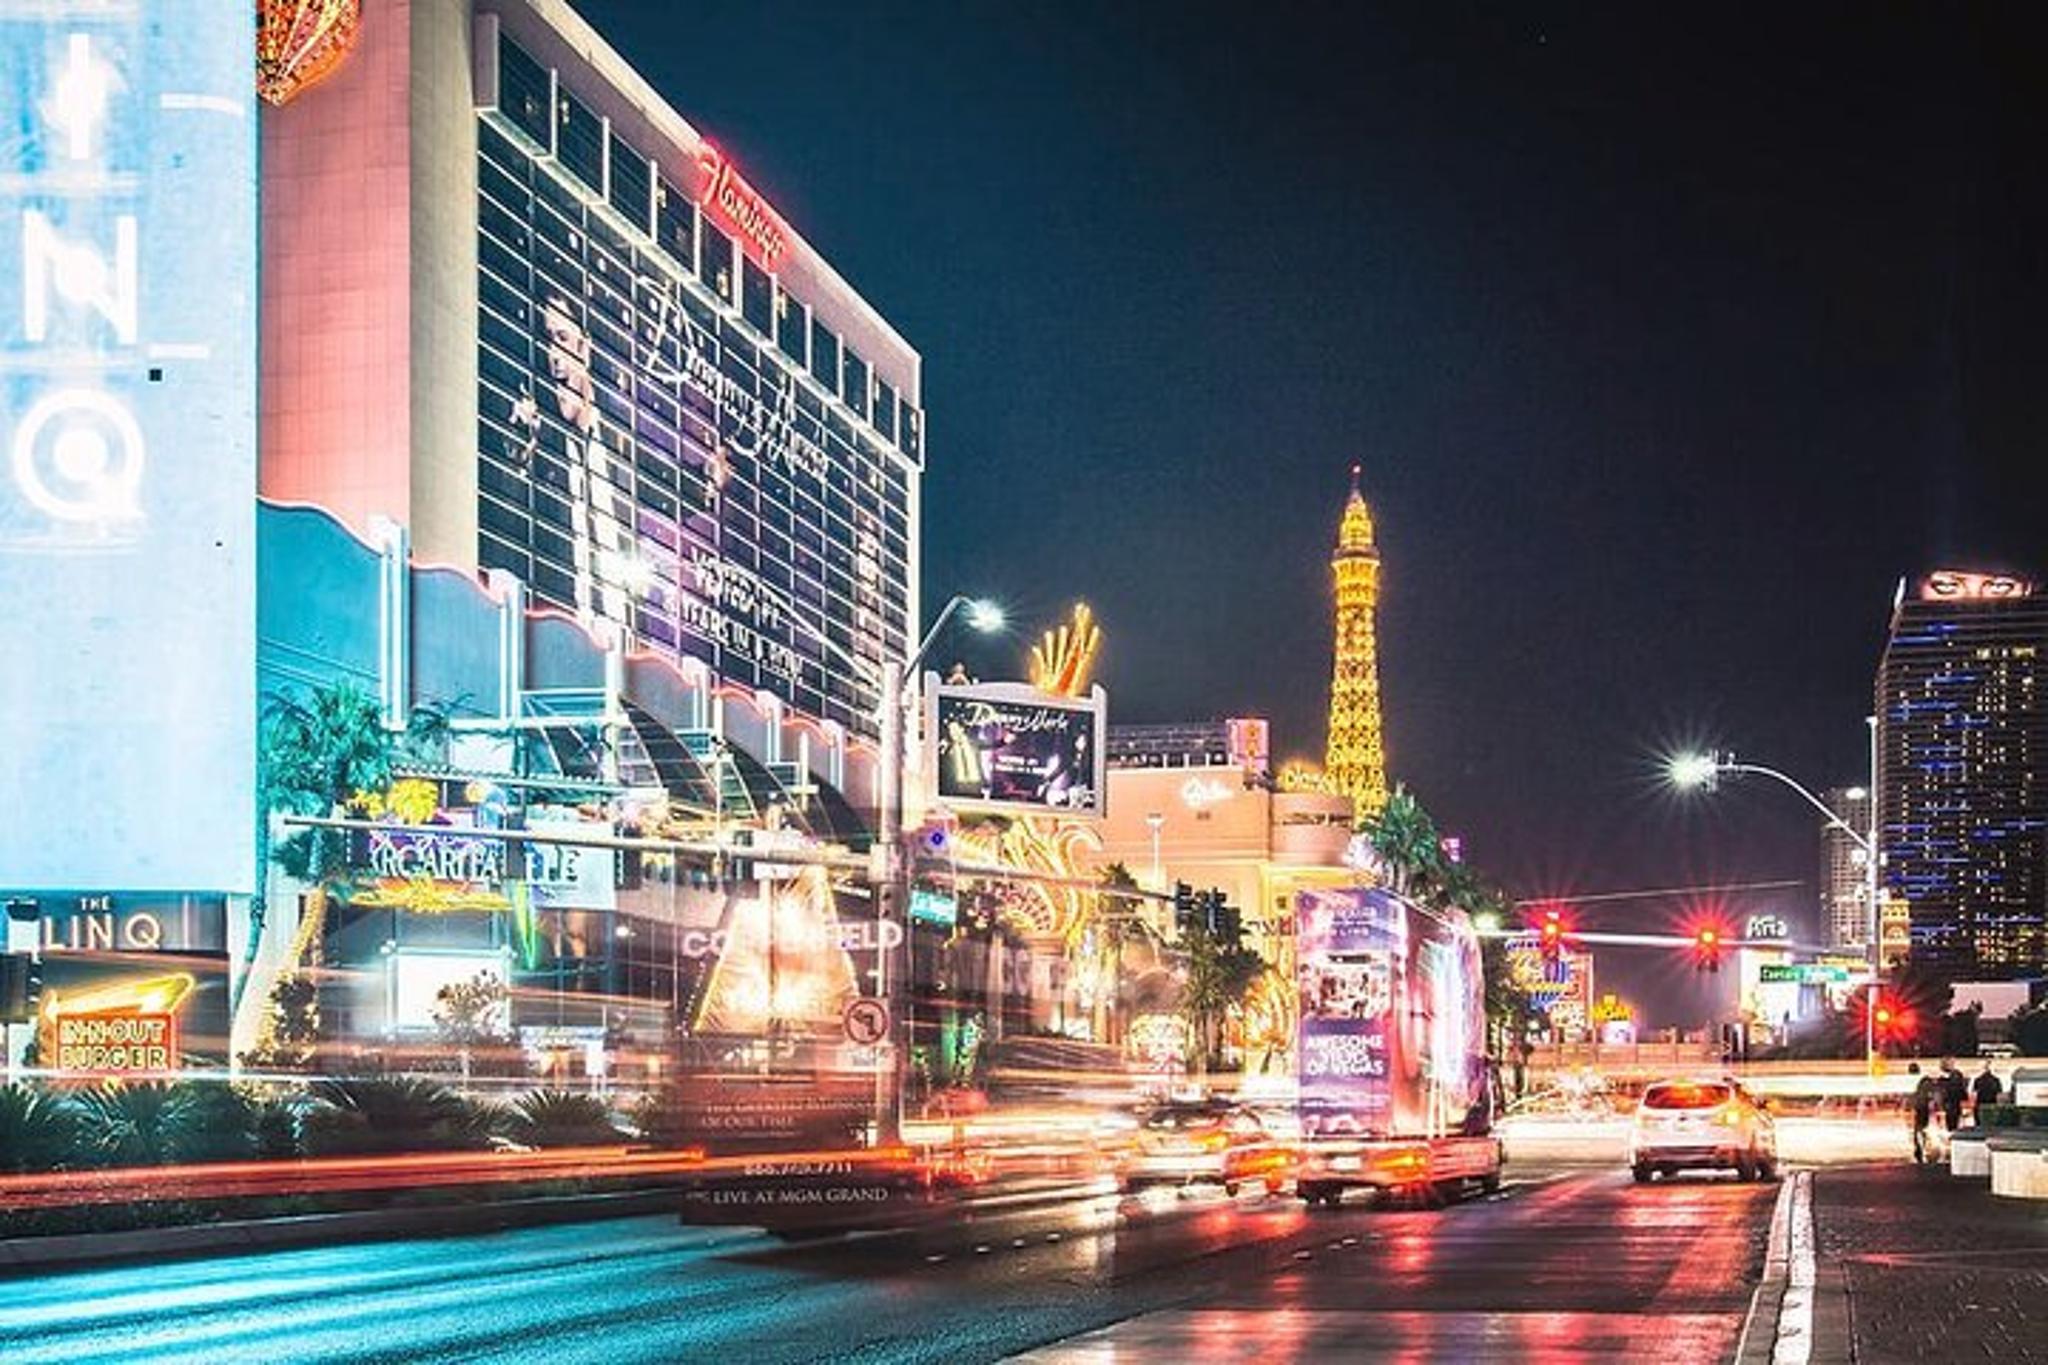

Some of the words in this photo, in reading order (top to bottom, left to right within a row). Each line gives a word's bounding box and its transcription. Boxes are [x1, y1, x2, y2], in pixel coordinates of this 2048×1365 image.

[699, 140, 786, 269] Flamingo
[80, 896, 111, 911] THE
[44, 912, 160, 951] LINQ
[59, 1046, 167, 1069] BURGER
[712, 1190, 748, 1204] LIVE
[754, 1189, 775, 1203] AT
[780, 1188, 823, 1203] MGM
[826, 1186, 889, 1202] GRAND
